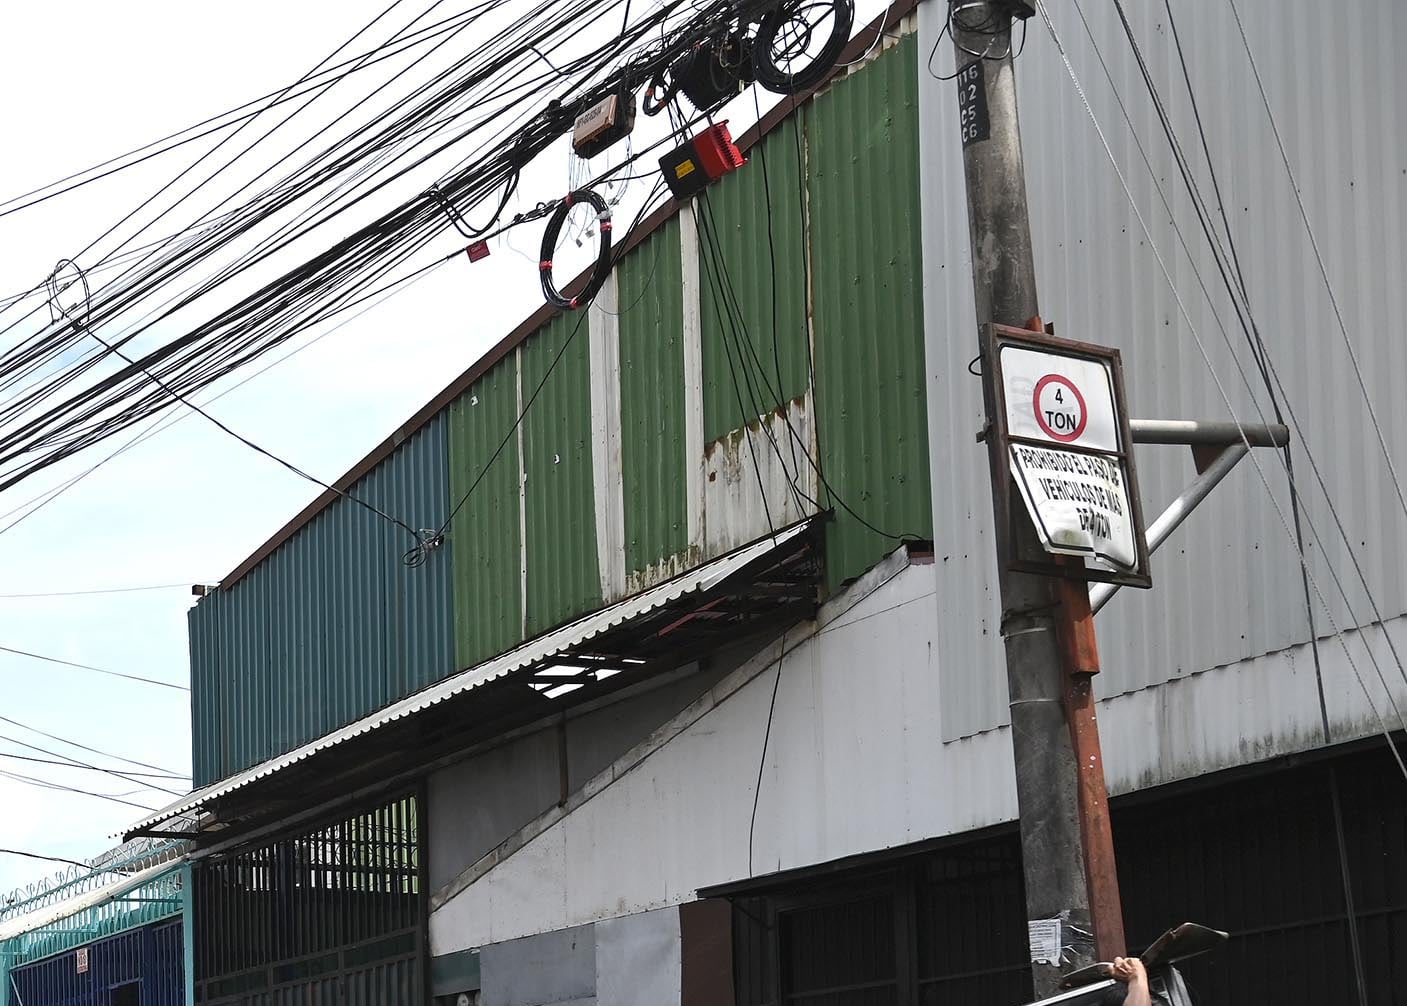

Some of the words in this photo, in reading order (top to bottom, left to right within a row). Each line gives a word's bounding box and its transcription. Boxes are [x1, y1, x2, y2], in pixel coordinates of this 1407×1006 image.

[1055, 388, 1064, 405] 4
[1045, 410, 1077, 431] TON
[1019, 448, 1074, 473] PROHIBIDO
[1071, 454, 1089, 476] EL
[1083, 456, 1110, 481] PASO
[1093, 486, 1109, 510] DE
